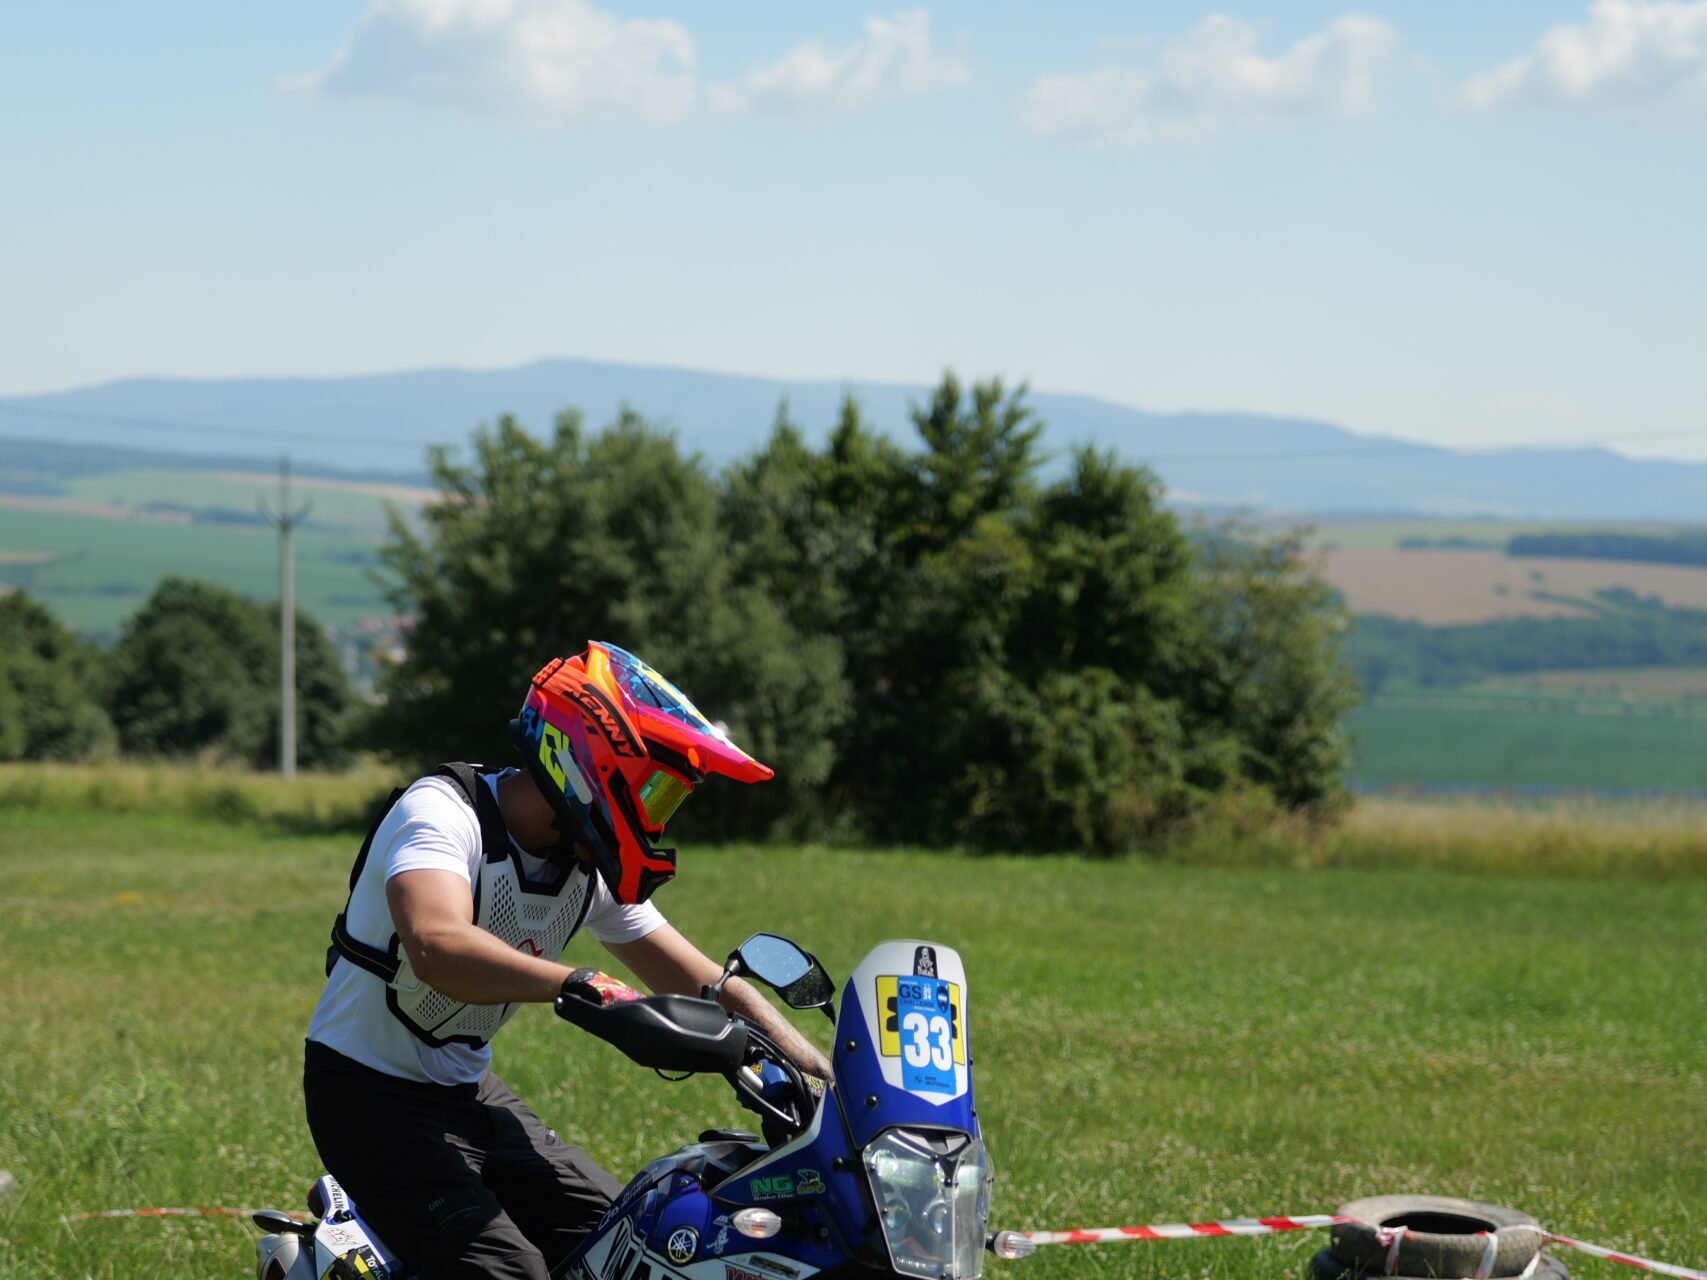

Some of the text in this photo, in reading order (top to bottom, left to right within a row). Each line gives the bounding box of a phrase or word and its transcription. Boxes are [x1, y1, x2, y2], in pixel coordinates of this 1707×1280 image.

[567, 687, 634, 757] KENNY
[899, 984, 921, 1000] GS
[899, 999, 934, 1008] CHALLENGE
[903, 1012, 952, 1071] 33
[751, 1175, 794, 1194] NG
